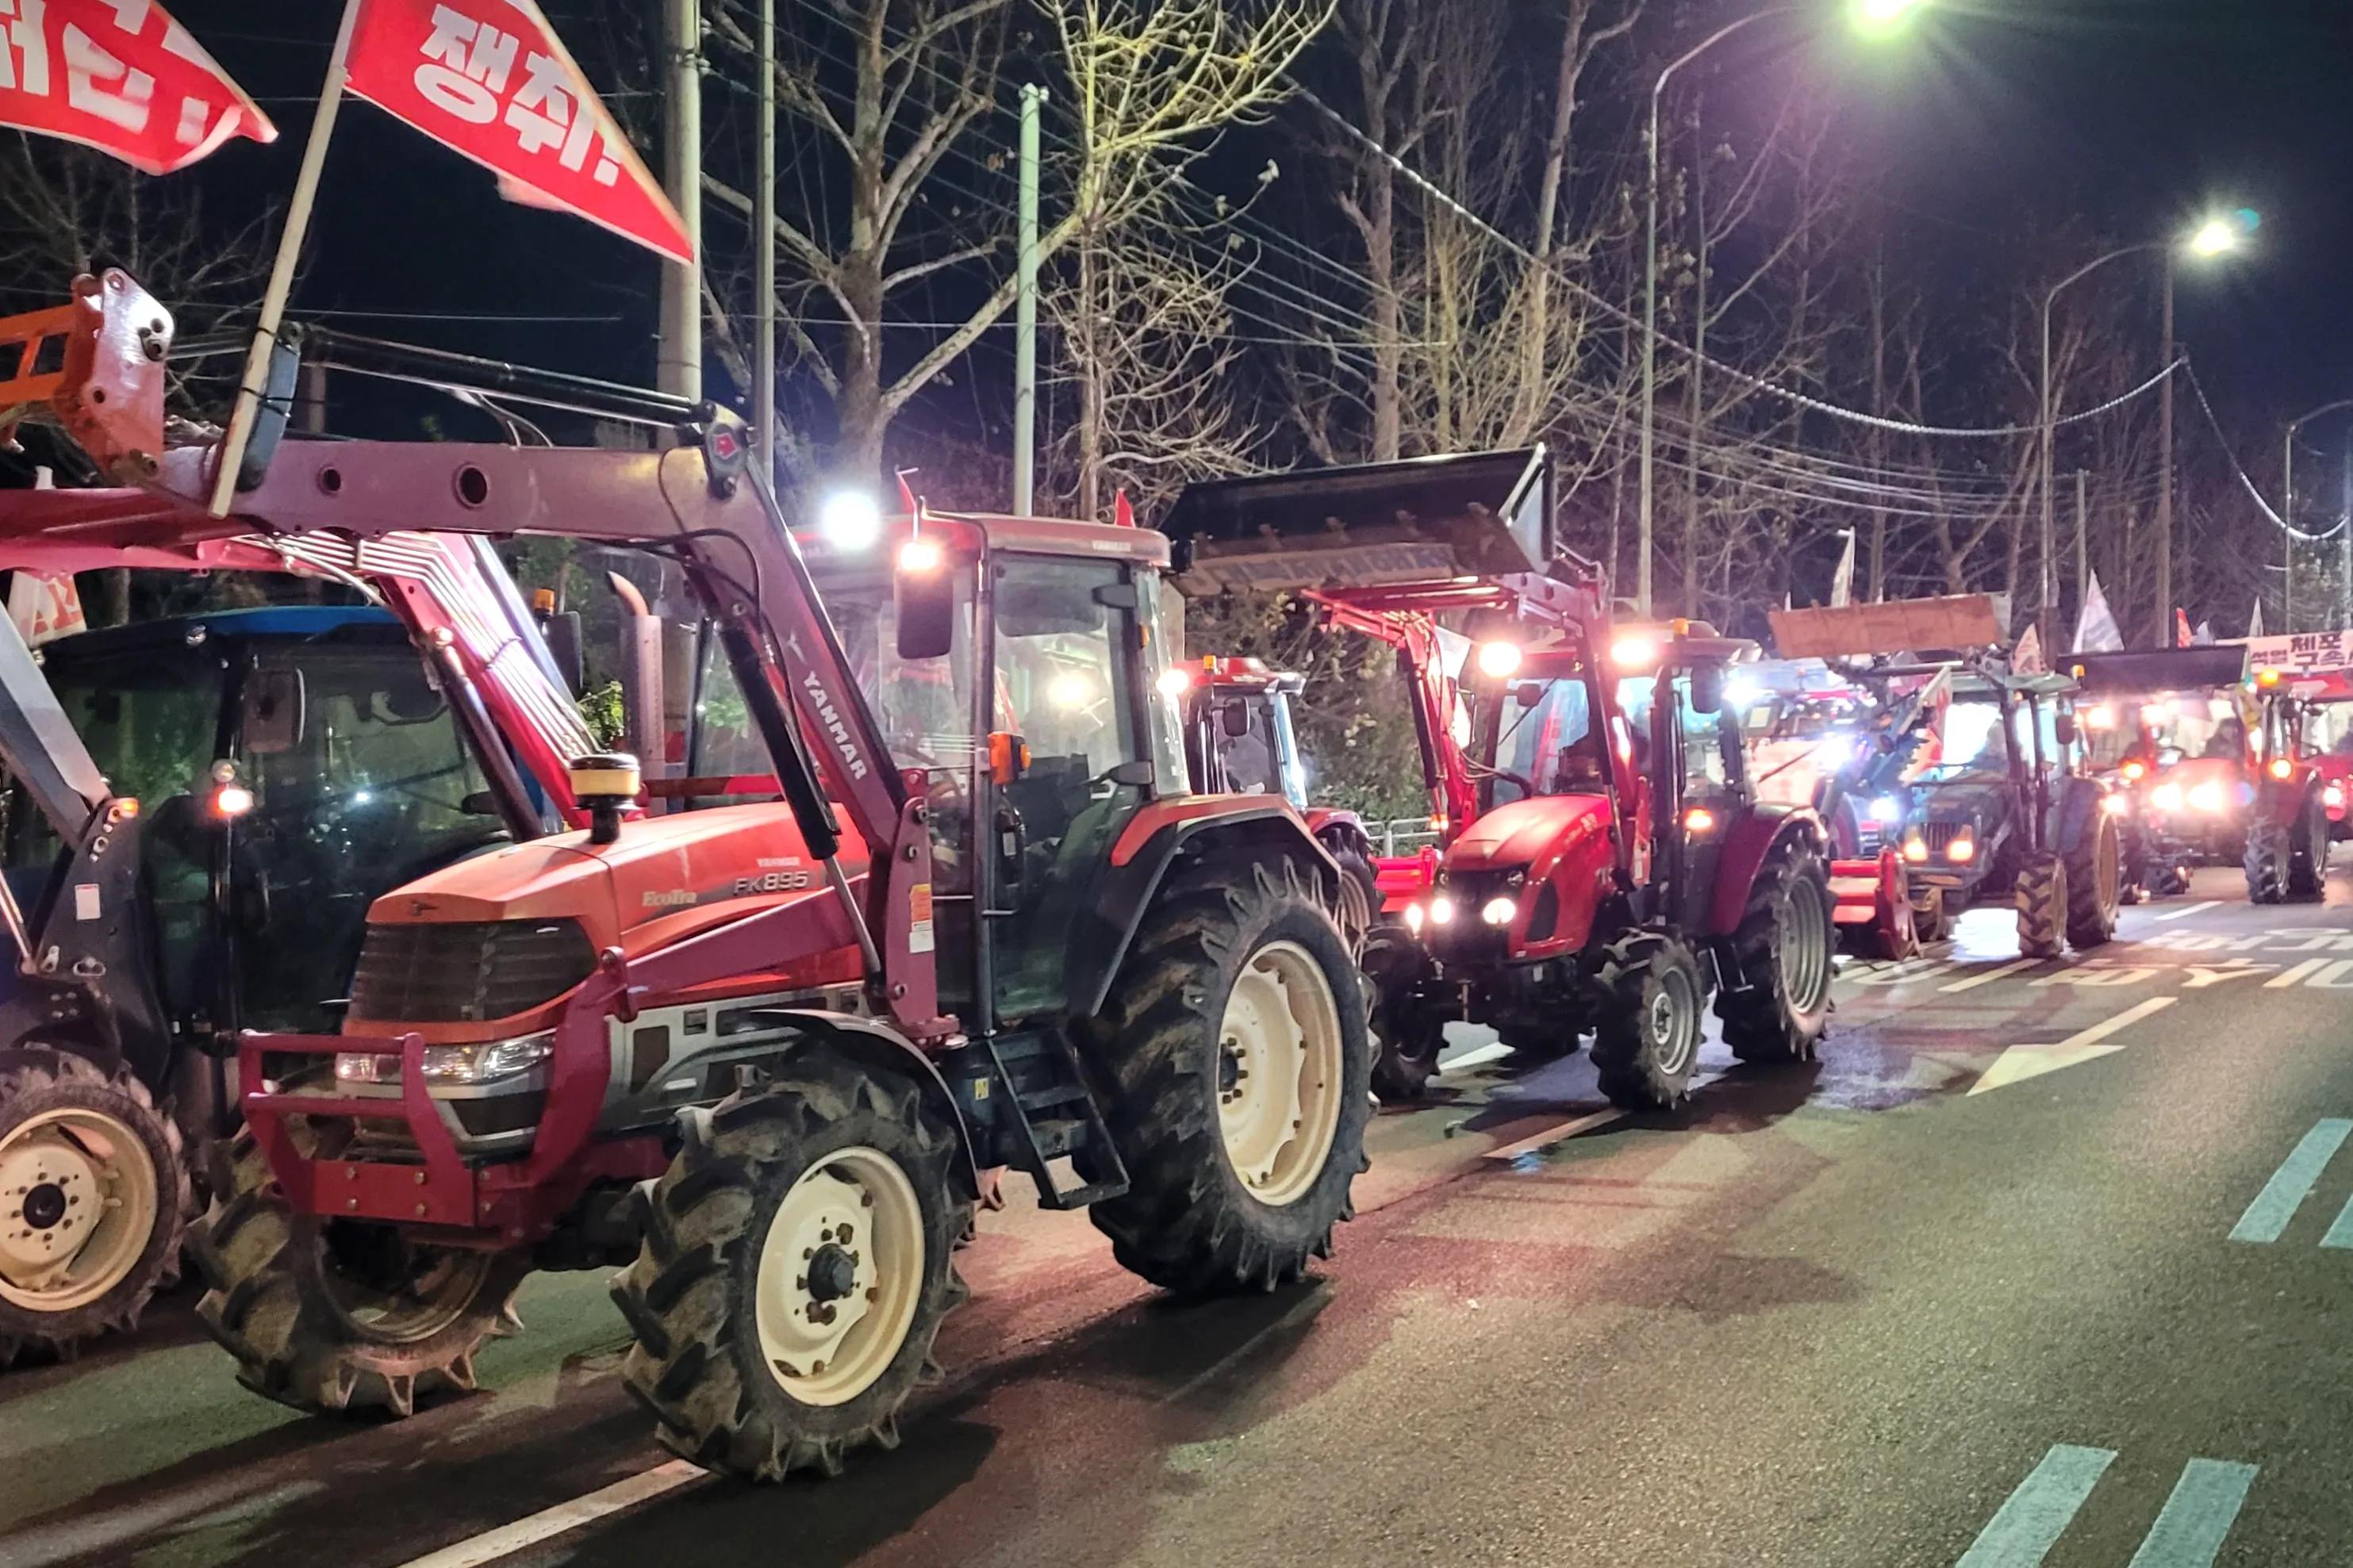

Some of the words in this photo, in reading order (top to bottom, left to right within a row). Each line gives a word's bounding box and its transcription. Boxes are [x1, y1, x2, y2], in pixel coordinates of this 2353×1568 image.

[2290, 634, 2343, 653] 체포
[2294, 650, 2353, 669] 구속
[803, 670, 868, 780] YANMAR
[733, 870, 808, 896] FK895
